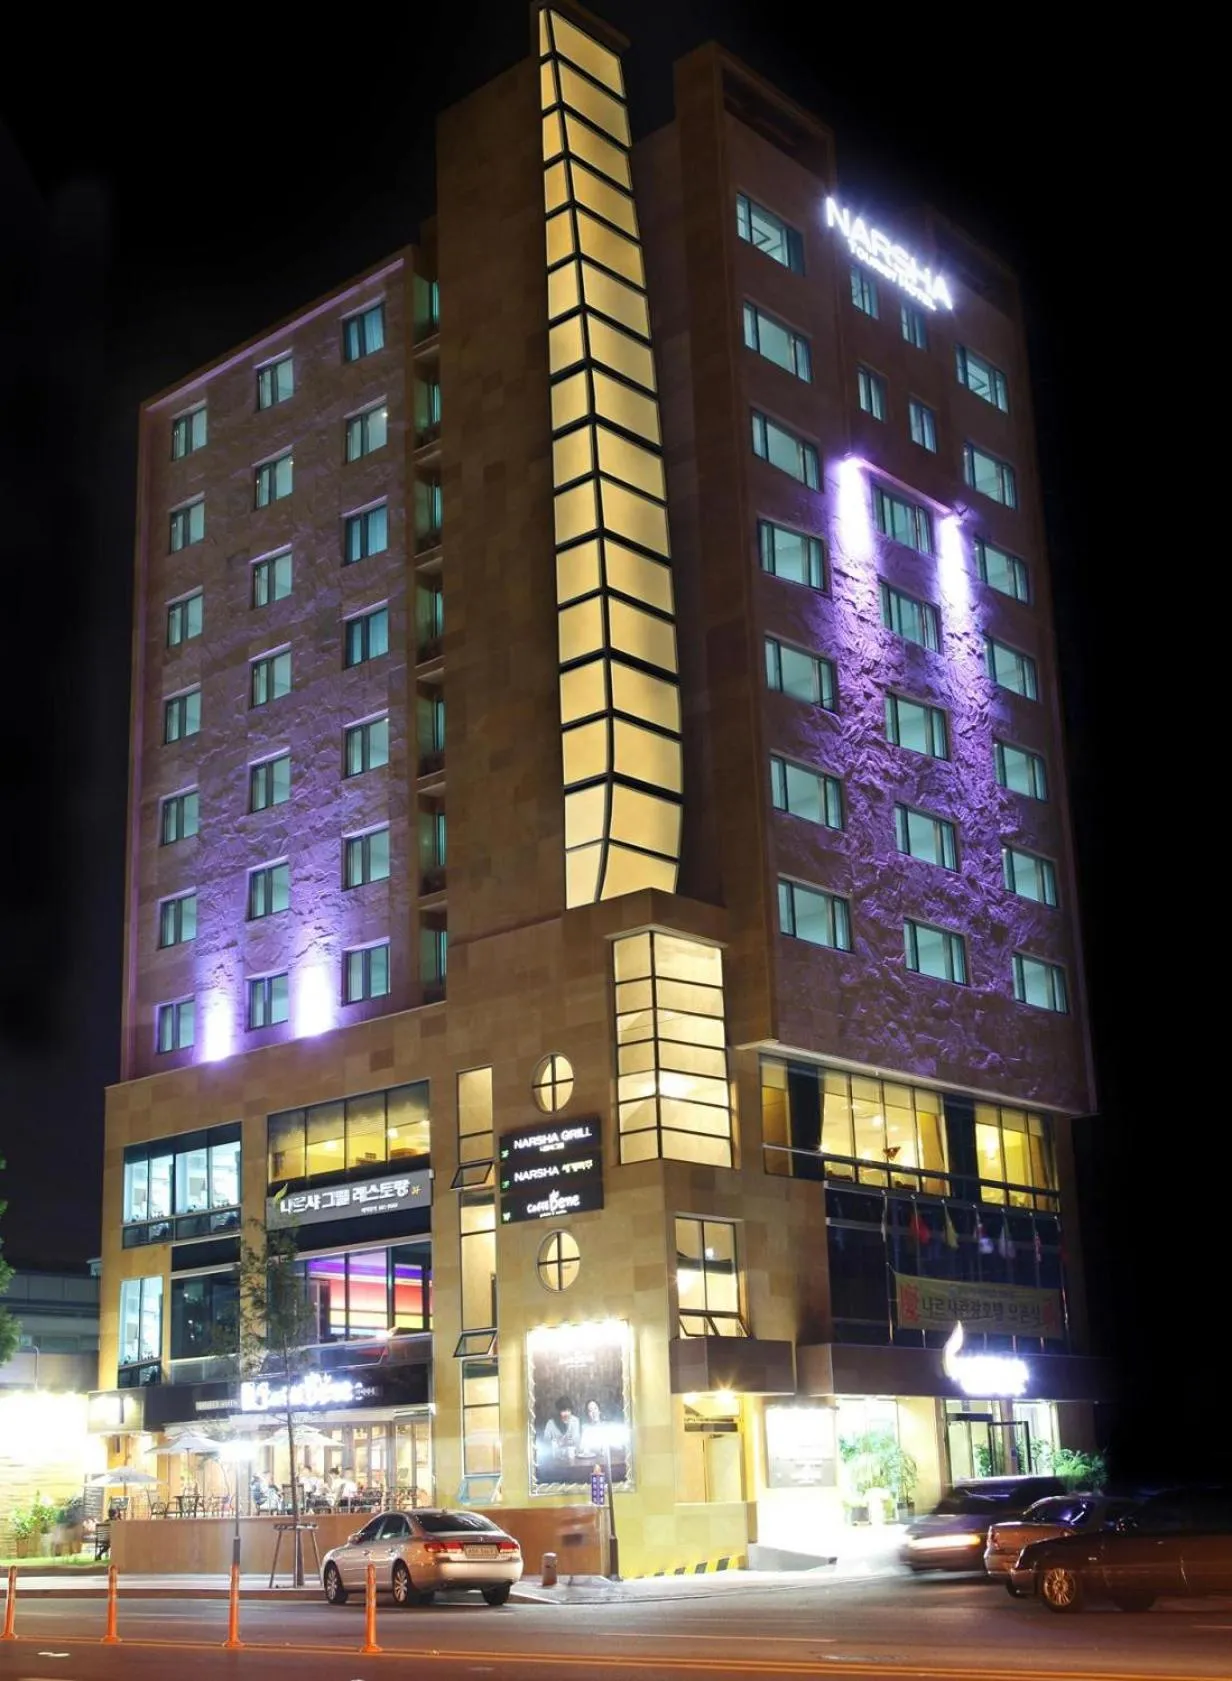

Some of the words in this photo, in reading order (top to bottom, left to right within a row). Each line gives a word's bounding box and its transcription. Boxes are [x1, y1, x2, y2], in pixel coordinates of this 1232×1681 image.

[826, 197, 953, 310] NARSHA
[514, 1133, 559, 1149] NARSHA
[561, 1127, 592, 1141] GRILL
[514, 1166, 559, 1182] NARSHA
[279, 1194, 321, 1214] 나르샤
[321, 1188, 350, 1208] 그릴
[352, 1178, 410, 1203] 레스토랑
